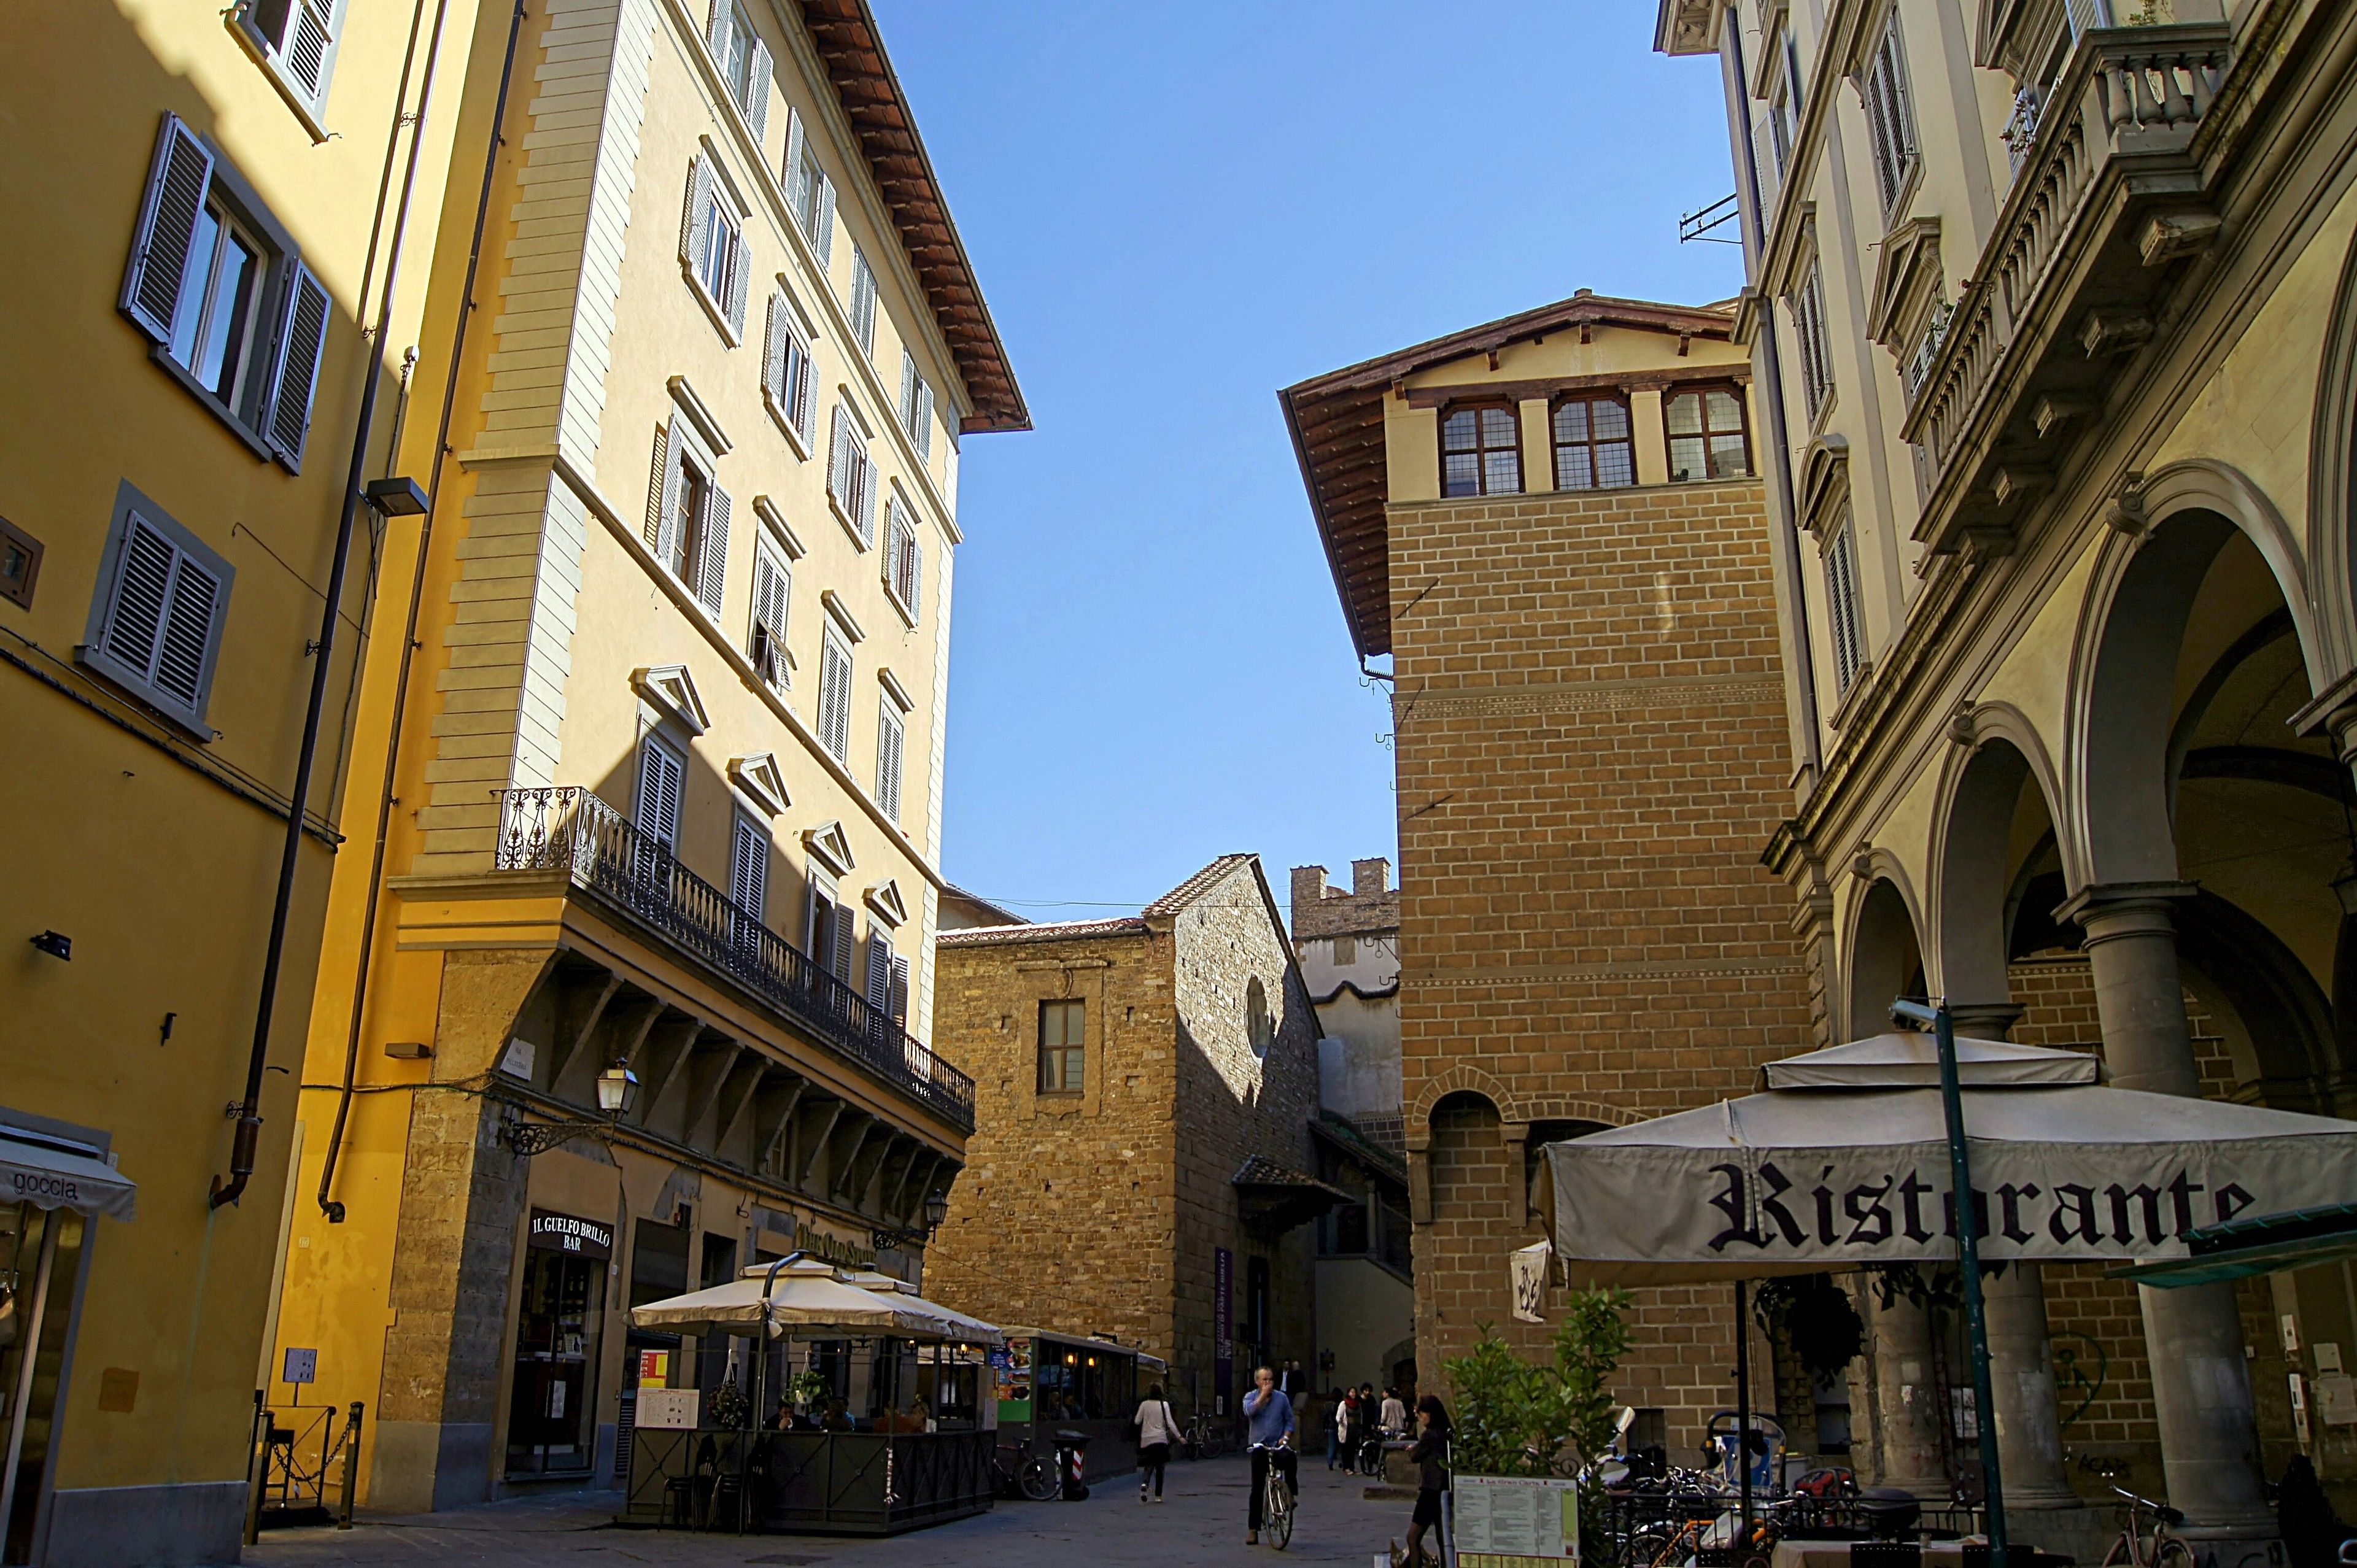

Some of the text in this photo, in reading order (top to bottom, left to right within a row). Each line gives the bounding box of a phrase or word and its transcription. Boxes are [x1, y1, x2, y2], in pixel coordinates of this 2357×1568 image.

[14, 1173, 79, 1200] goccia
[1708, 1162, 2256, 1253] Ristorante
[532, 1217, 610, 1247] IL GUELFO BRILLO
[563, 1235, 581, 1251] BAR
